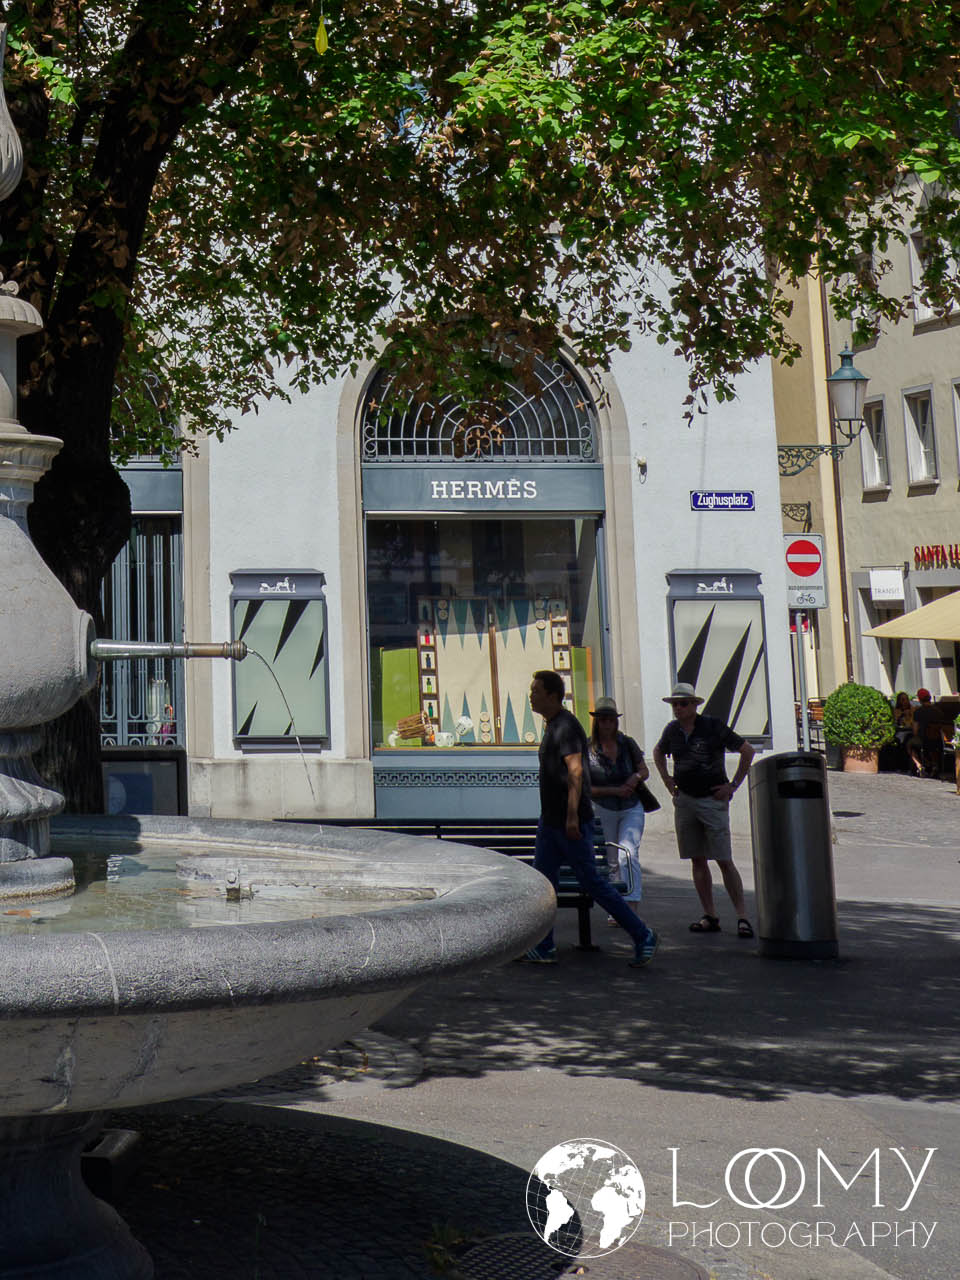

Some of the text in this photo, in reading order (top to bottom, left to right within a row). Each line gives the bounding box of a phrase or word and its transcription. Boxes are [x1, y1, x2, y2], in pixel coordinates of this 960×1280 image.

[431, 479, 537, 498] HERMÈS
[697, 493, 749, 508] Züghusplatz
[914, 544, 948, 562] SANTA
